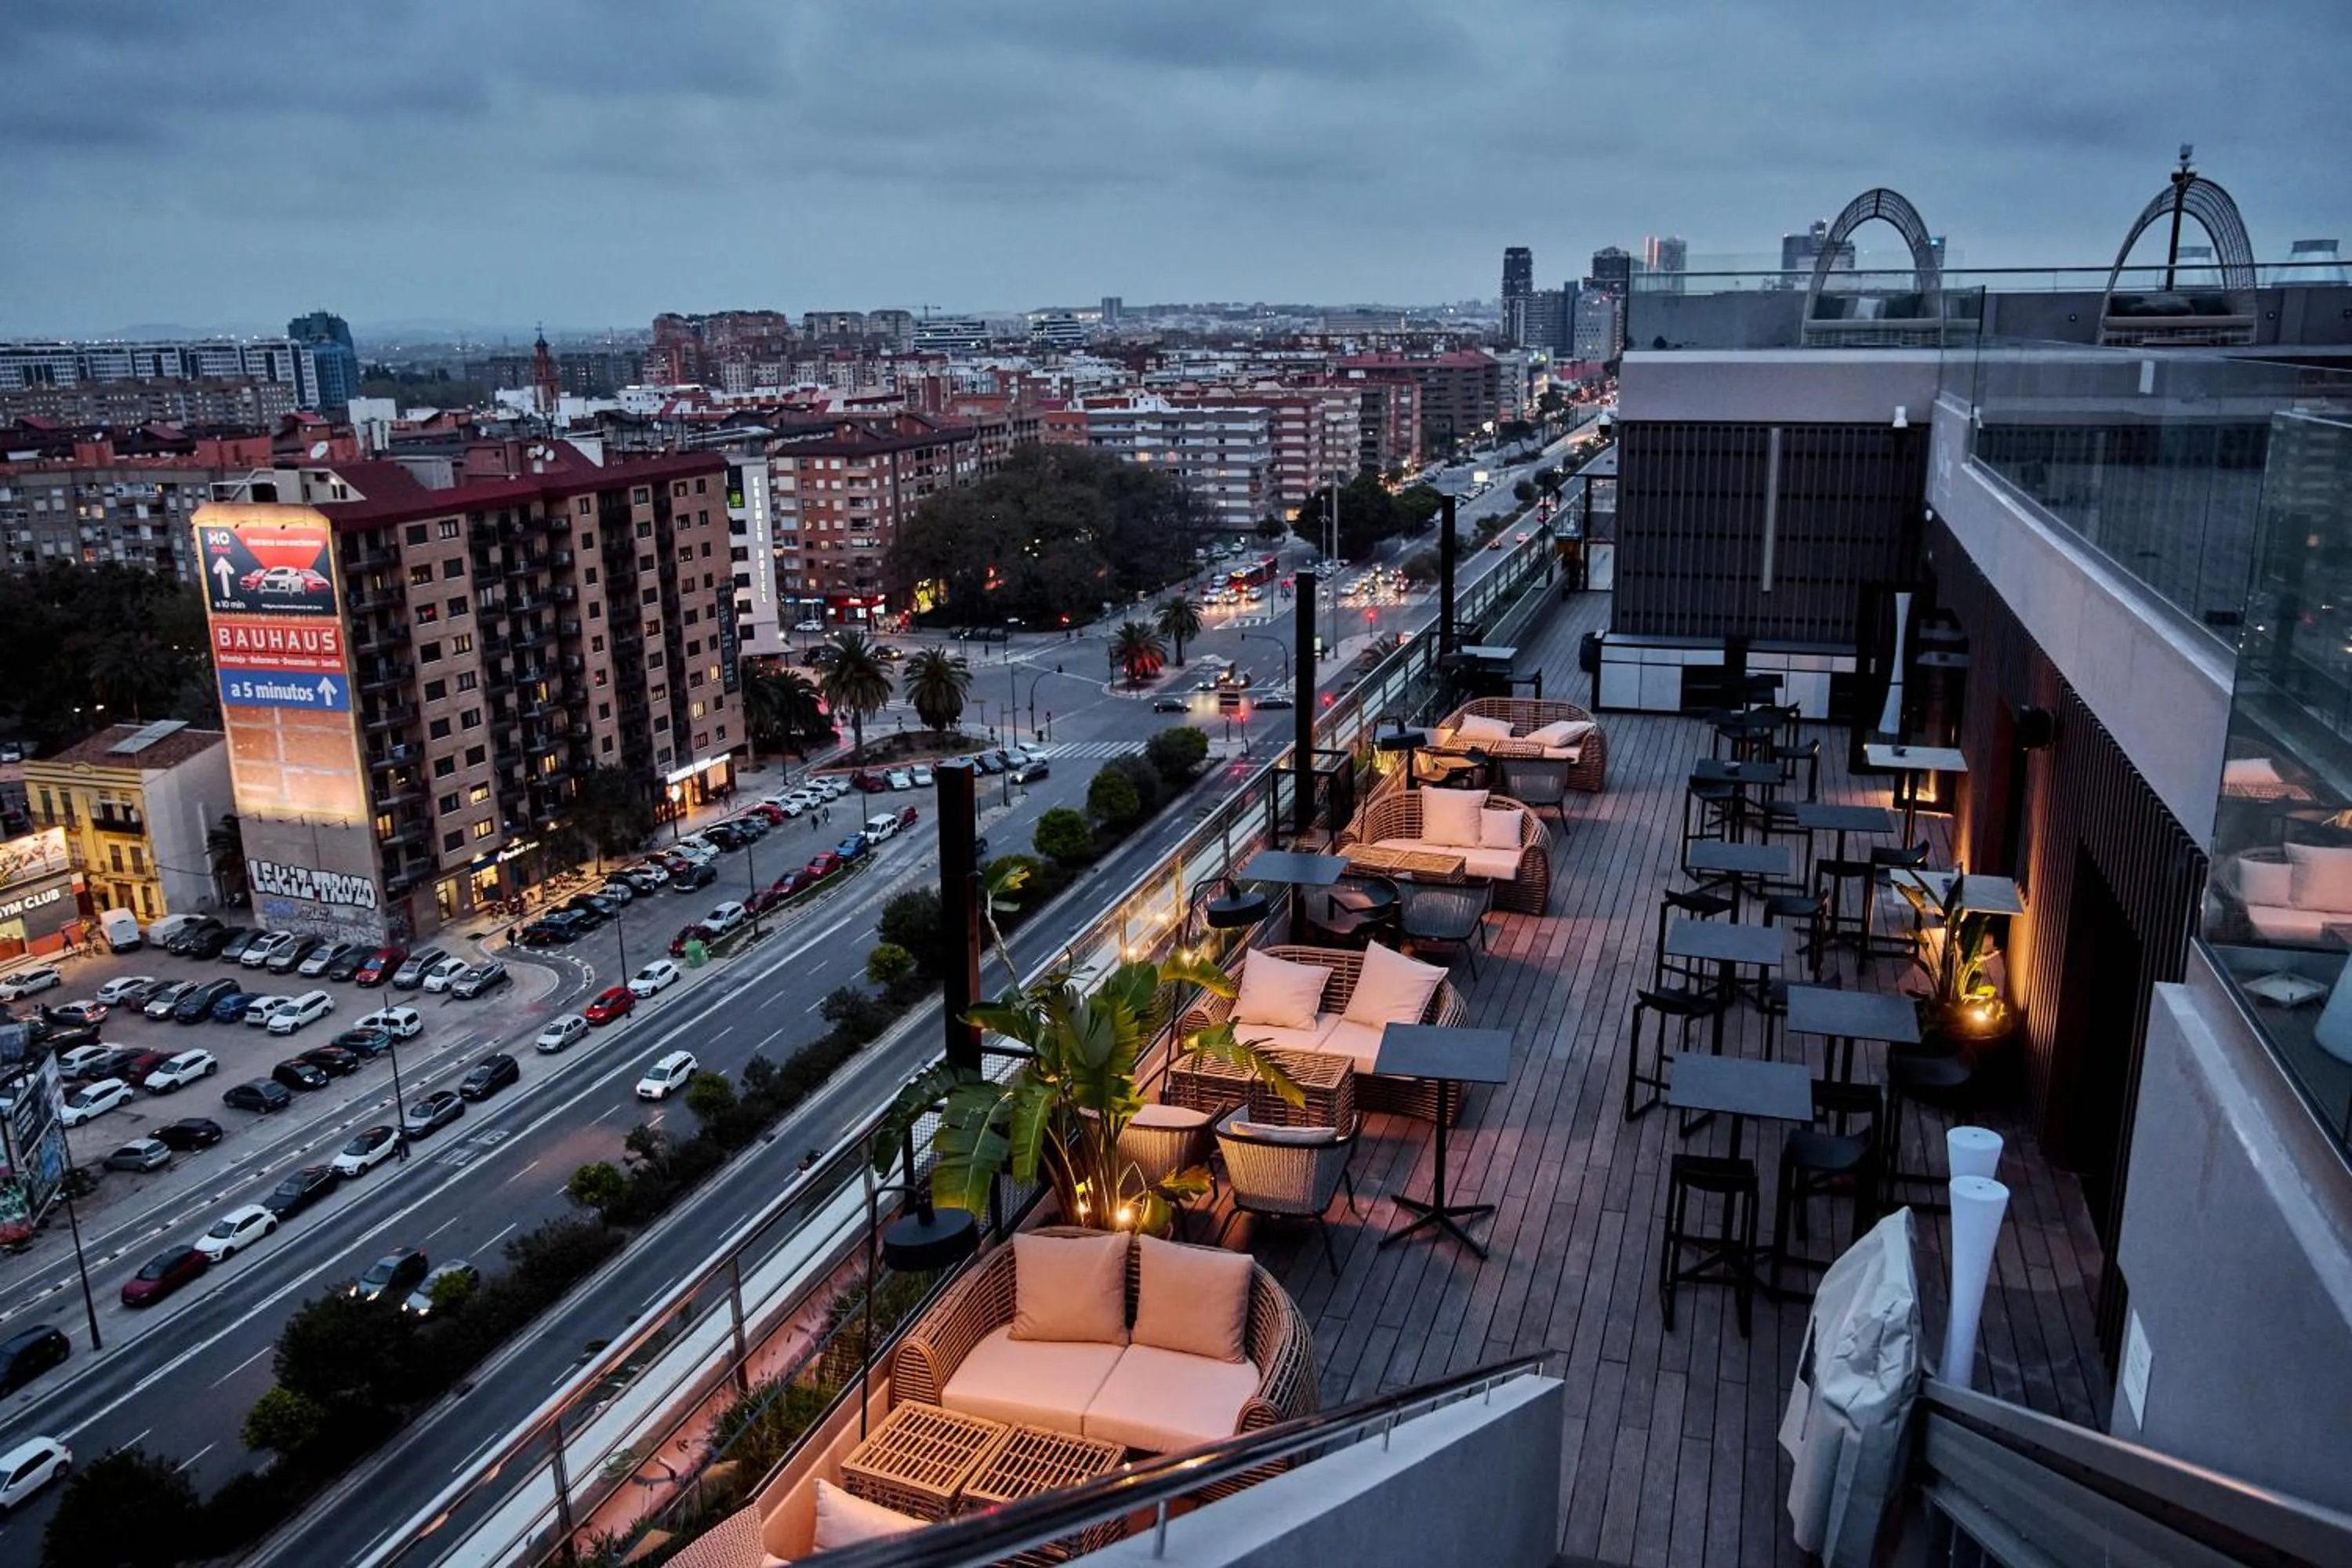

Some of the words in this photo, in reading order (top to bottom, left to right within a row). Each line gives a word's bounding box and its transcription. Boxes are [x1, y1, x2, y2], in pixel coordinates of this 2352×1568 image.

[758, 548, 767, 603] HOTEL
[230, 601, 245, 609] min
[218, 627, 336, 652] BAUHAUS
[230, 683, 241, 697] a
[243, 681, 252, 698] 5
[255, 681, 314, 702] minutos
[24, 888, 60, 909] CLUB
